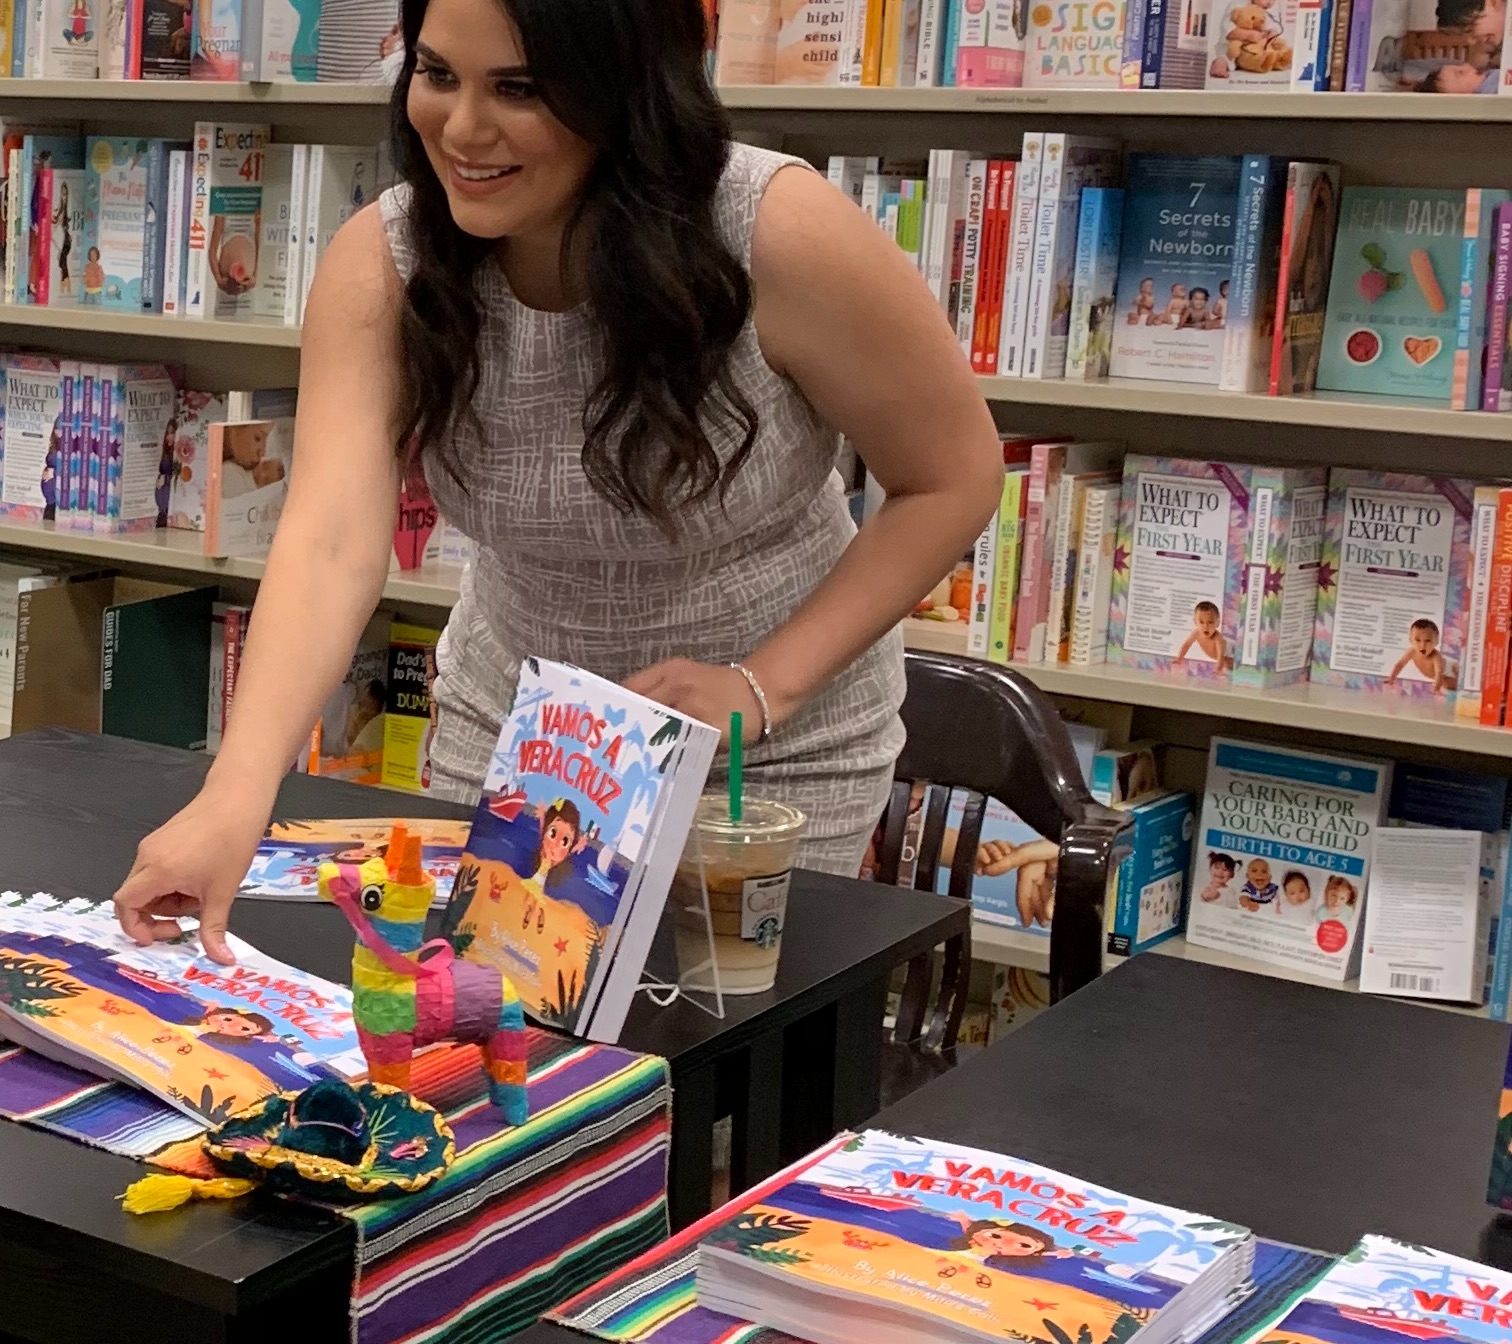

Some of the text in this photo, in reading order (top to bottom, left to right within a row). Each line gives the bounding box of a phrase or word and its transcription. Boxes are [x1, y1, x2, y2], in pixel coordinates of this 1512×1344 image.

[804, 31, 841, 43] sensi
[923, 21, 933, 49] BIBLE
[802, 50, 839, 62] child
[1041, 55, 1120, 76] BASIC
[189, 153, 209, 250] Expecting 411
[1189, 183, 1206, 208] 7
[1015, 198, 1034, 273] Toilet Time
[1159, 209, 1231, 228] Secrets
[1177, 229, 1209, 238] of the
[1405, 200, 1466, 237] BABY
[1036, 200, 1054, 274] Toilet Time
[1240, 175, 1265, 317] 7 Secrets Newborn
[960, 228, 979, 314] POTTY TRAINING
[1489, 222, 1511, 369] BABY SIGNING ESSENTIALS
[8, 377, 59, 399] WHAT TO
[8, 396, 46, 414] EXPECT
[129, 391, 153, 407] WHAT
[127, 408, 160, 423] EXPECT
[1142, 483, 1219, 511] WHAT TO
[1350, 497, 1441, 527] WHAT TO
[1139, 505, 1203, 528] EXPECT
[1255, 494, 1268, 560] WHAT EXPECT
[1348, 521, 1423, 544] EXPECT
[979, 536, 992, 567] rules
[1136, 527, 1223, 556] FIRST YEAR
[1345, 544, 1444, 573] FIRST YEAR
[1495, 565, 1511, 632] DISCIPLINE
[16, 594, 32, 692] For New Parents
[103, 611, 115, 690] GUIDES FOR DAD
[225, 641, 236, 696] THE EXPECTANT
[393, 668, 404, 680] to
[542, 703, 623, 768] VAMOS A
[518, 740, 622, 816] VERACRUZ
[1213, 793, 1369, 837] YOUR BABY AND
[1228, 781, 1354, 817] CARING FOR
[1218, 811, 1359, 852] YOUNG CHILD
[1221, 833, 1350, 872] BIRTH TO AGE 5
[184, 966, 349, 1040] VERACRUZ
[233, 967, 335, 1008] VAMOS
[891, 1171, 1141, 1248] VERACRUZ
[944, 1160, 1129, 1227] VAMOS A
[855, 1259, 875, 1274] By
[884, 1269, 933, 1288] Alice
